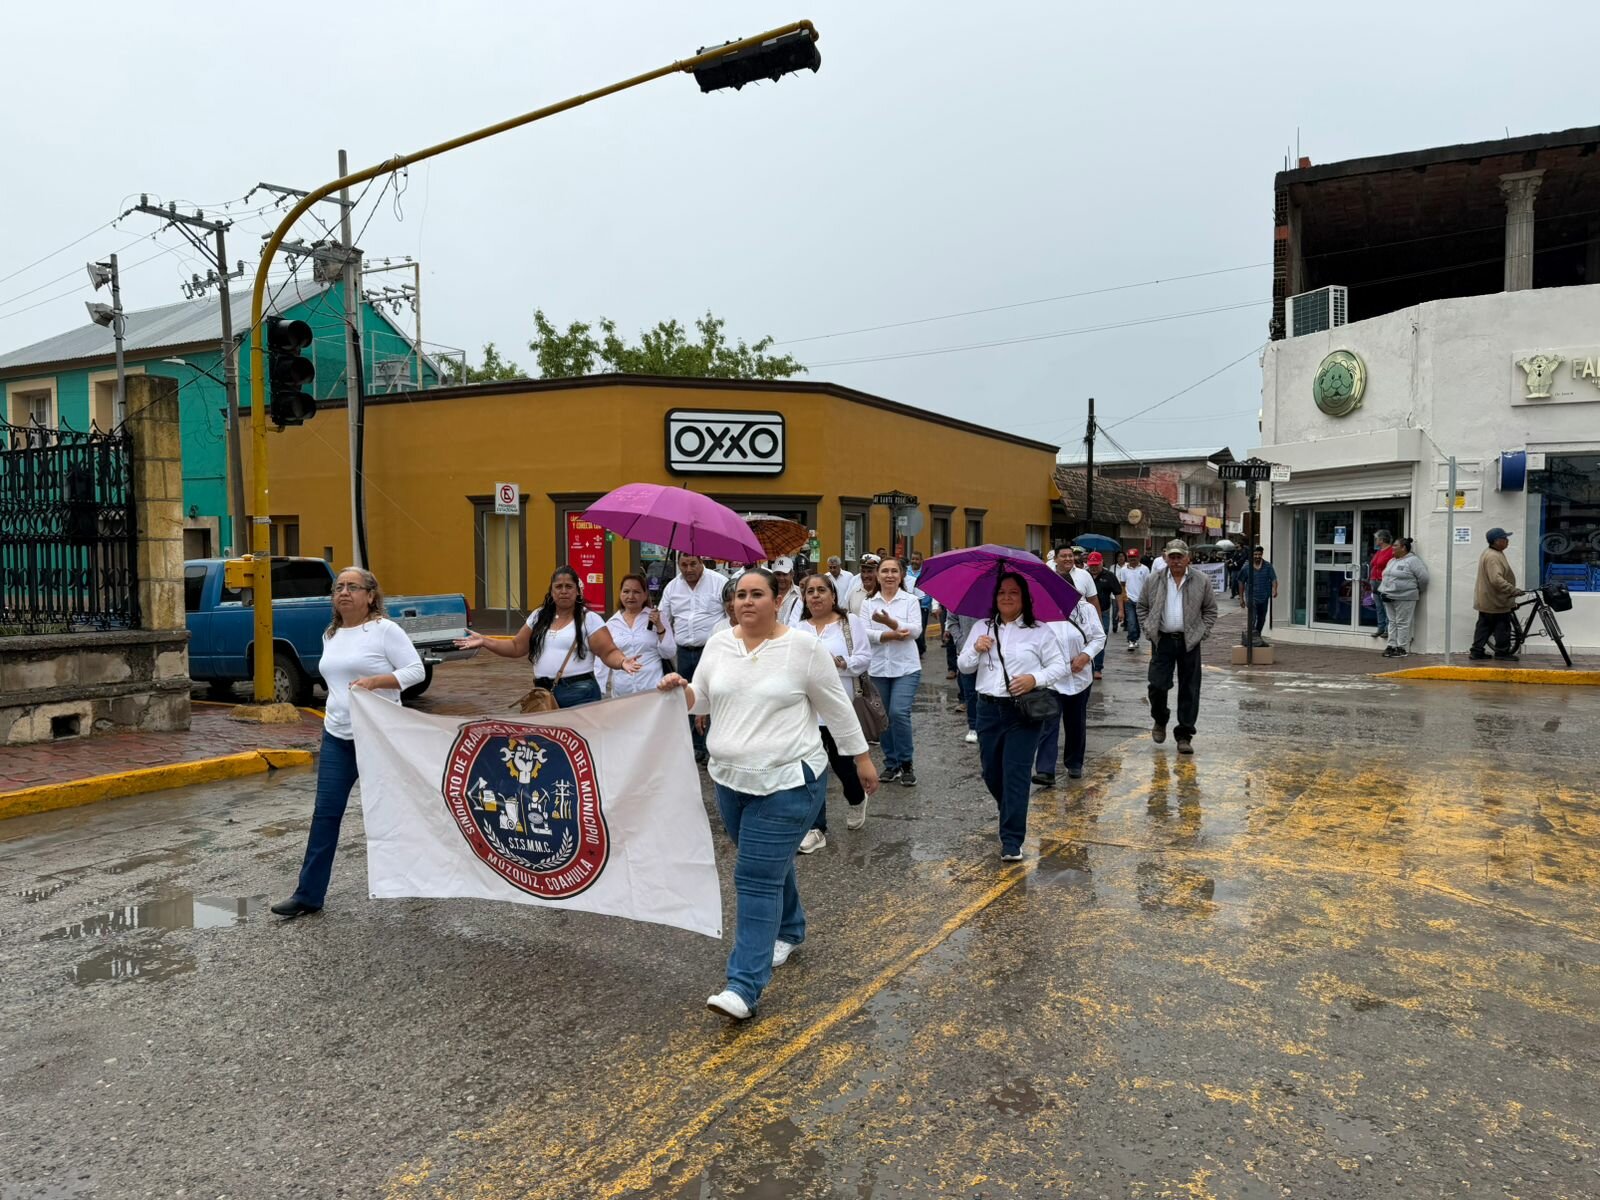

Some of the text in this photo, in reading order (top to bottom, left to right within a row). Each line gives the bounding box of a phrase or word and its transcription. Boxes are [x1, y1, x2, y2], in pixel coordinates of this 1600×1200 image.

[675, 423, 778, 461] OXXO
[1221, 467, 1242, 477] SANTA
[1251, 467, 1267, 478] ROSA
[454, 756, 468, 774] DE
[574, 751, 588, 778] DEL
[450, 777, 475, 835] SINDICATO
[580, 780, 599, 845] MUNICIPIO
[545, 858, 594, 891] COAHUILA
